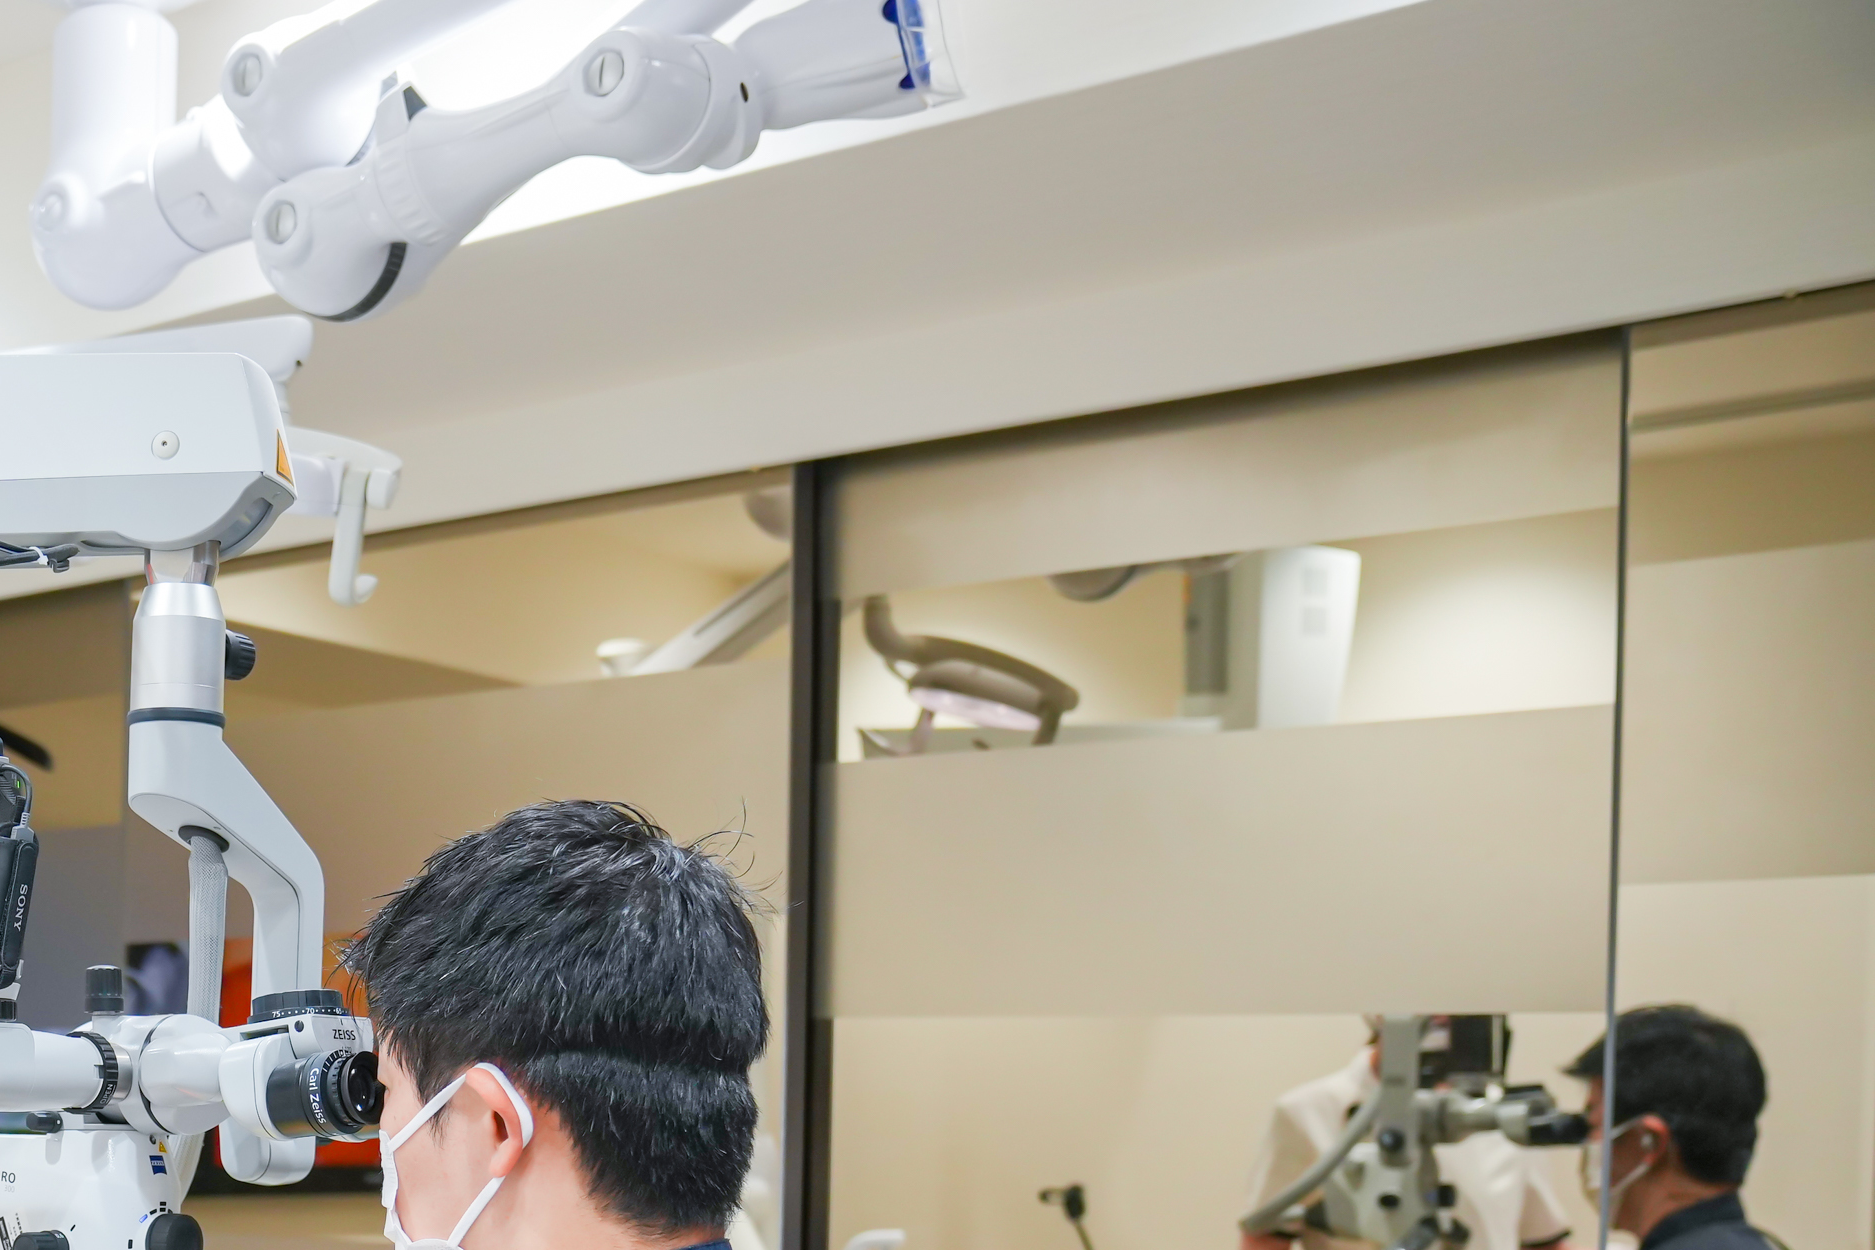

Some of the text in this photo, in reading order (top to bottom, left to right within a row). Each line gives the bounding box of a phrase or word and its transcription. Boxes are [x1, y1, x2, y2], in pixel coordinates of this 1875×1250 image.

[13, 884, 28, 932] SONY
[332, 1029, 356, 1041] ZEISS
[100, 1083, 114, 1105] OPEN
[308, 1067, 327, 1124] Carl Zeiss
[4, 1184, 15, 1193] 300
